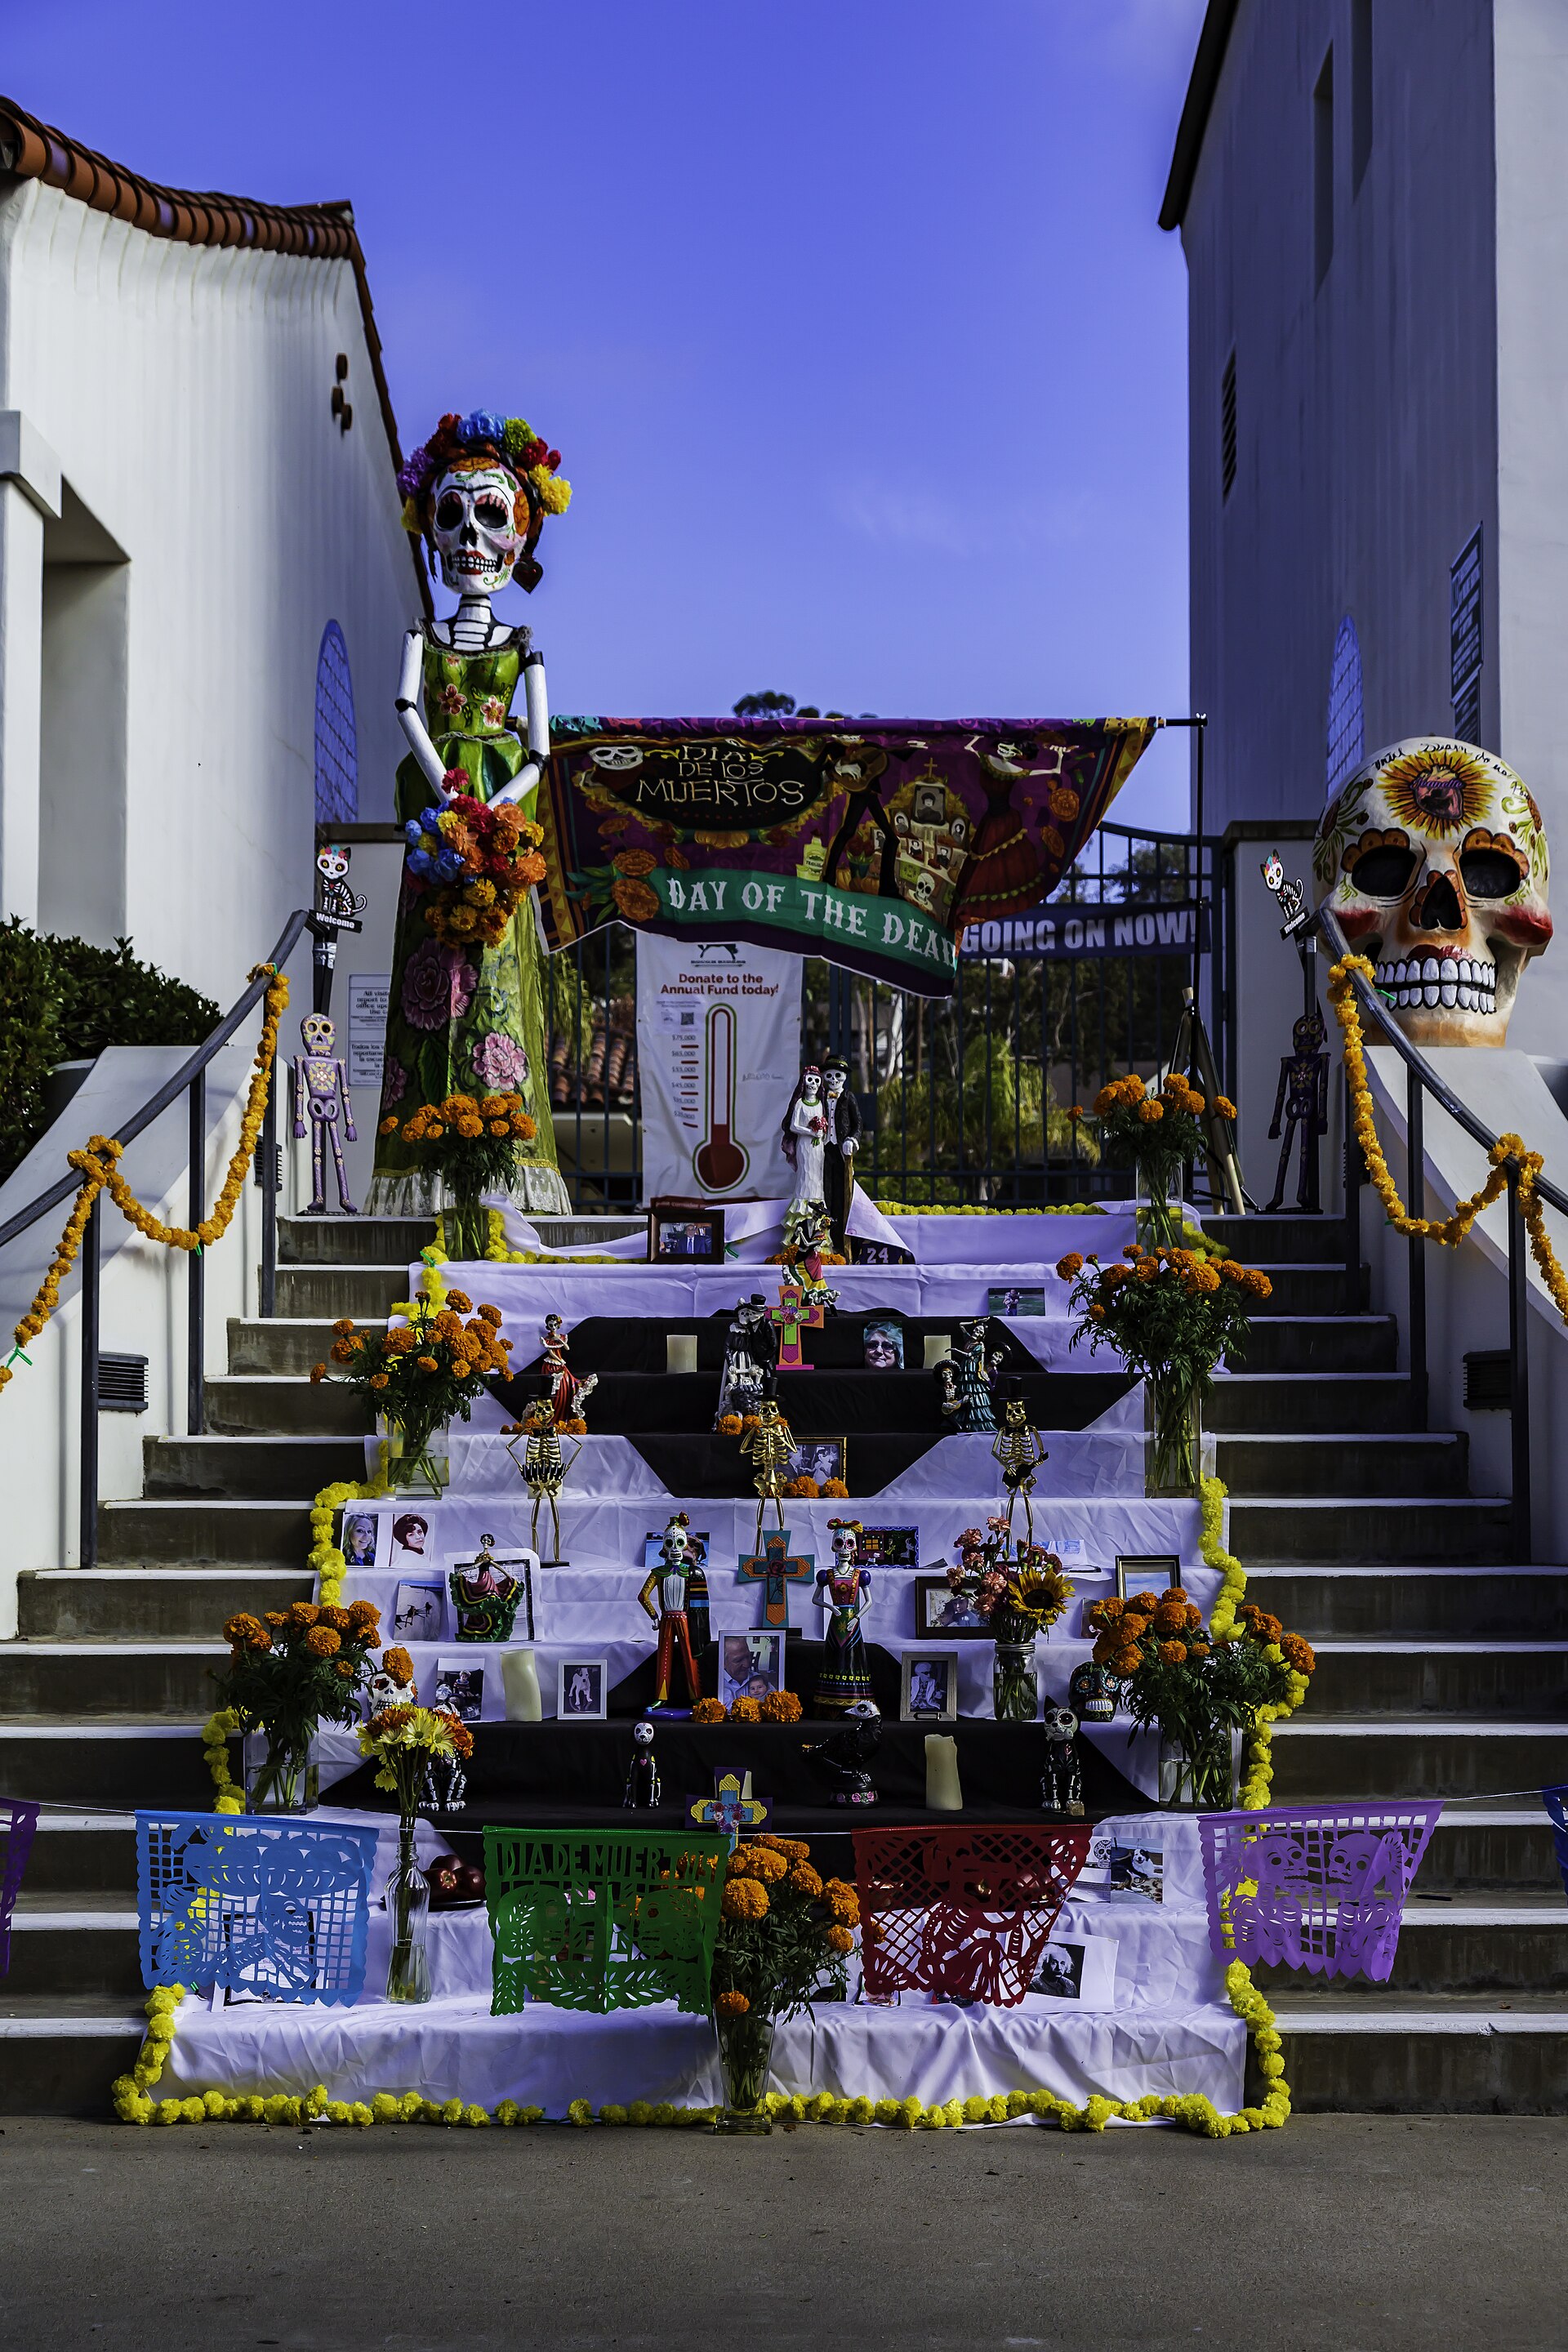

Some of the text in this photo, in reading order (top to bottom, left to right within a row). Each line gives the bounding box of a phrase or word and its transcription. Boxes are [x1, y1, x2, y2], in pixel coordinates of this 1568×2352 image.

[682, 745, 746, 762] DIA
[679, 762, 764, 779] DE LOS
[636, 777, 805, 806] MUERTOS
[316, 912, 355, 929] Welcome
[666, 877, 956, 968] DAY OF THE DEAD
[960, 910, 1196, 953] GOING ON NOW!
[679, 973, 763, 983] Donate to the
[661, 983, 778, 996] Annual Fund today!
[867, 1247, 889, 1263] 24
[501, 1842, 547, 1877] DIA
[553, 1843, 582, 1878] DE
